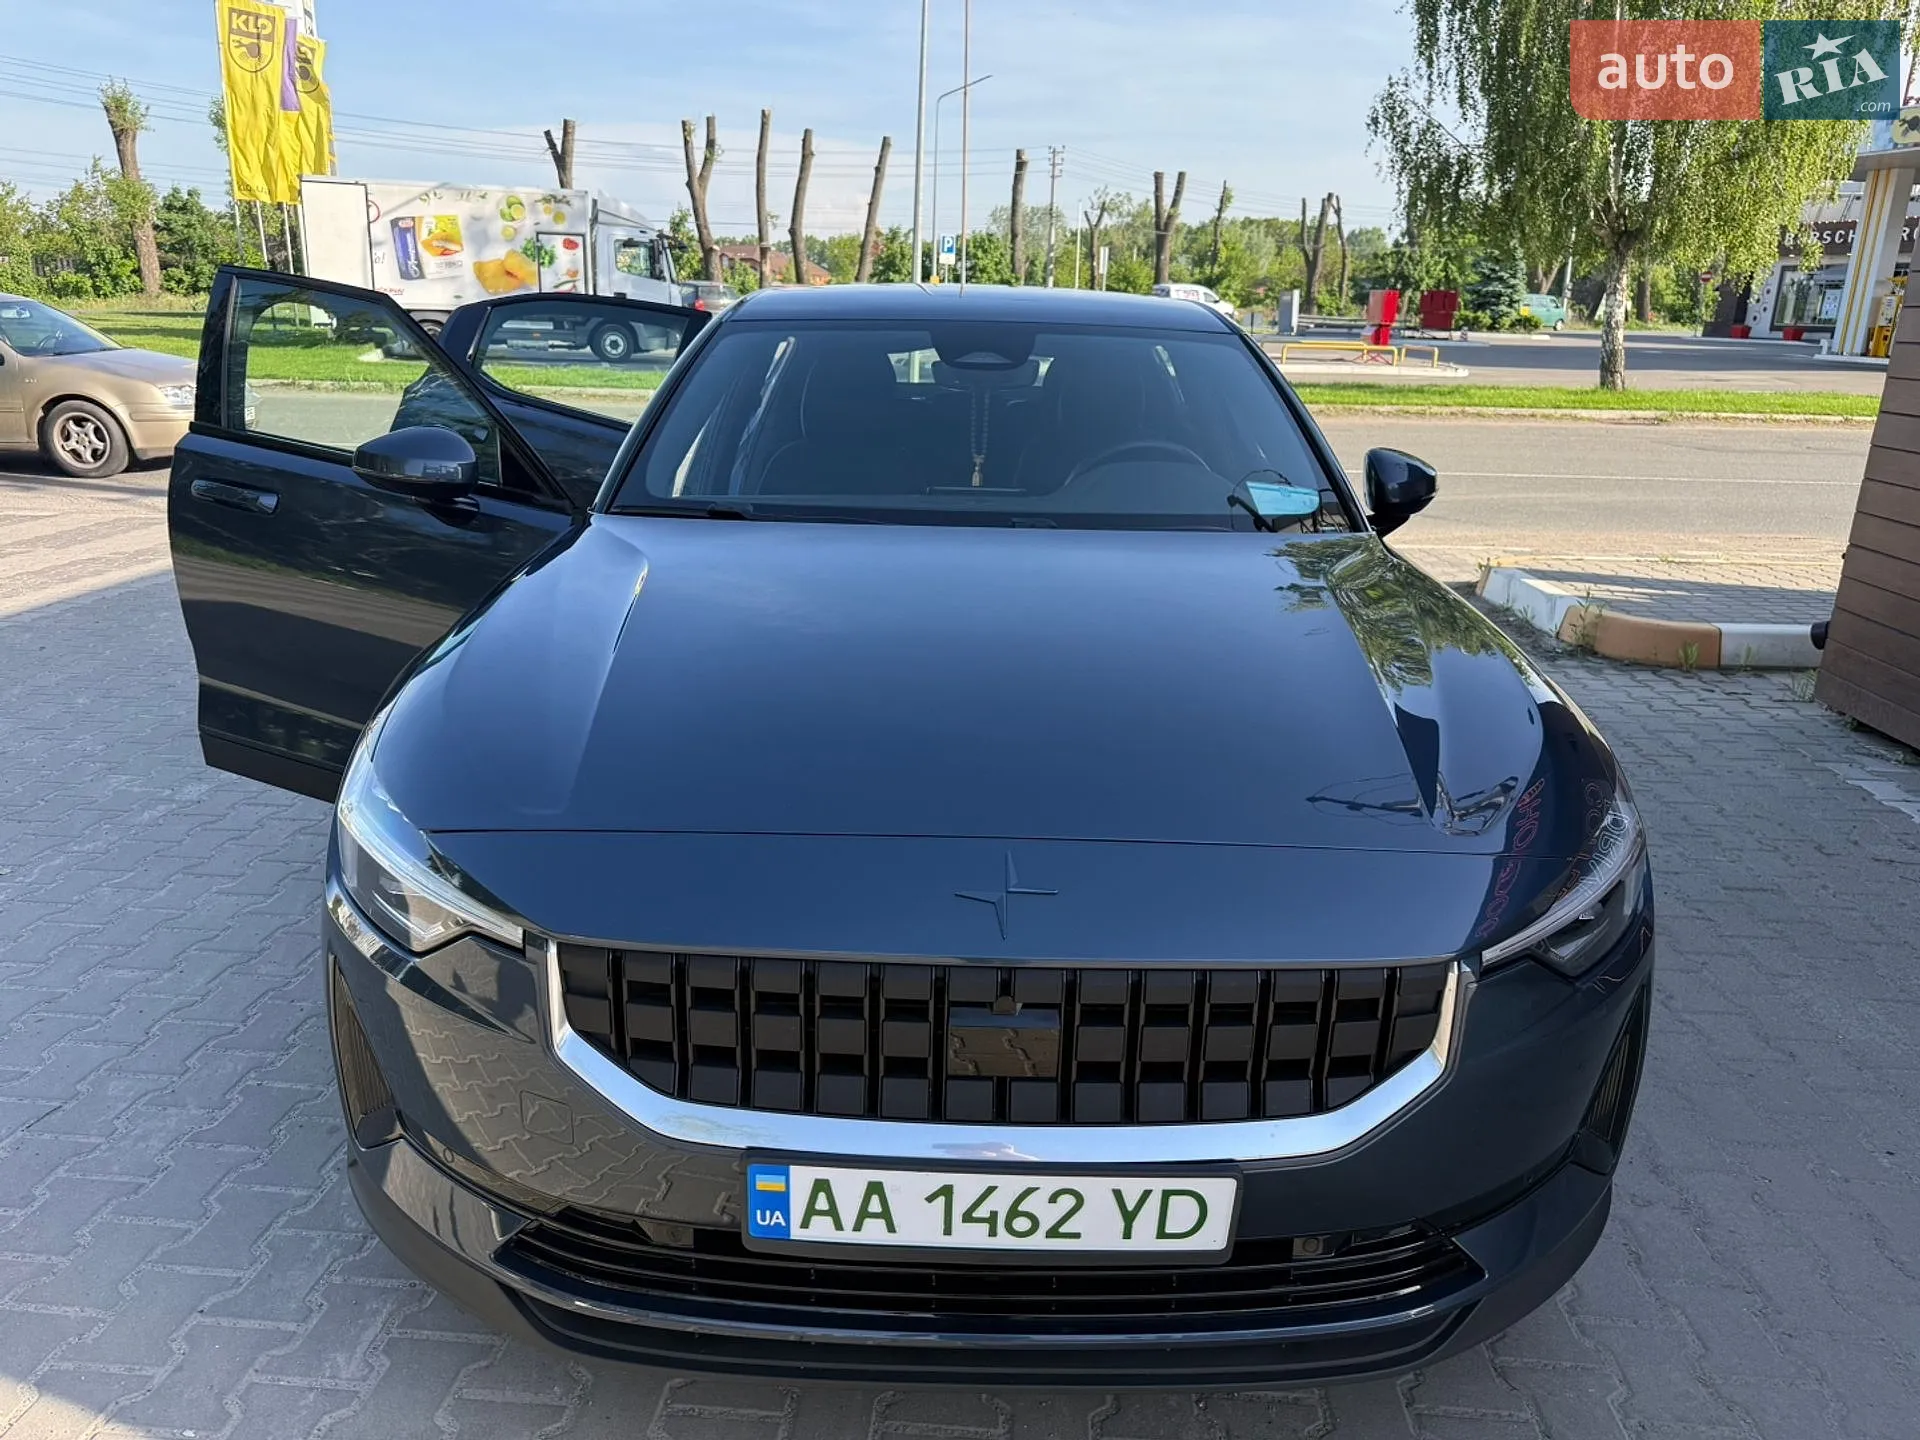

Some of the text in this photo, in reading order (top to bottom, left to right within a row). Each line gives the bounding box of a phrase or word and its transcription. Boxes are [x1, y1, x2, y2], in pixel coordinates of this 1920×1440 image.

[944, 237, 953, 252] P
[1785, 229, 1856, 245] BRSCH
[800, 1178, 1208, 1240] AA 1462 YD
[755, 1209, 786, 1226] UA
